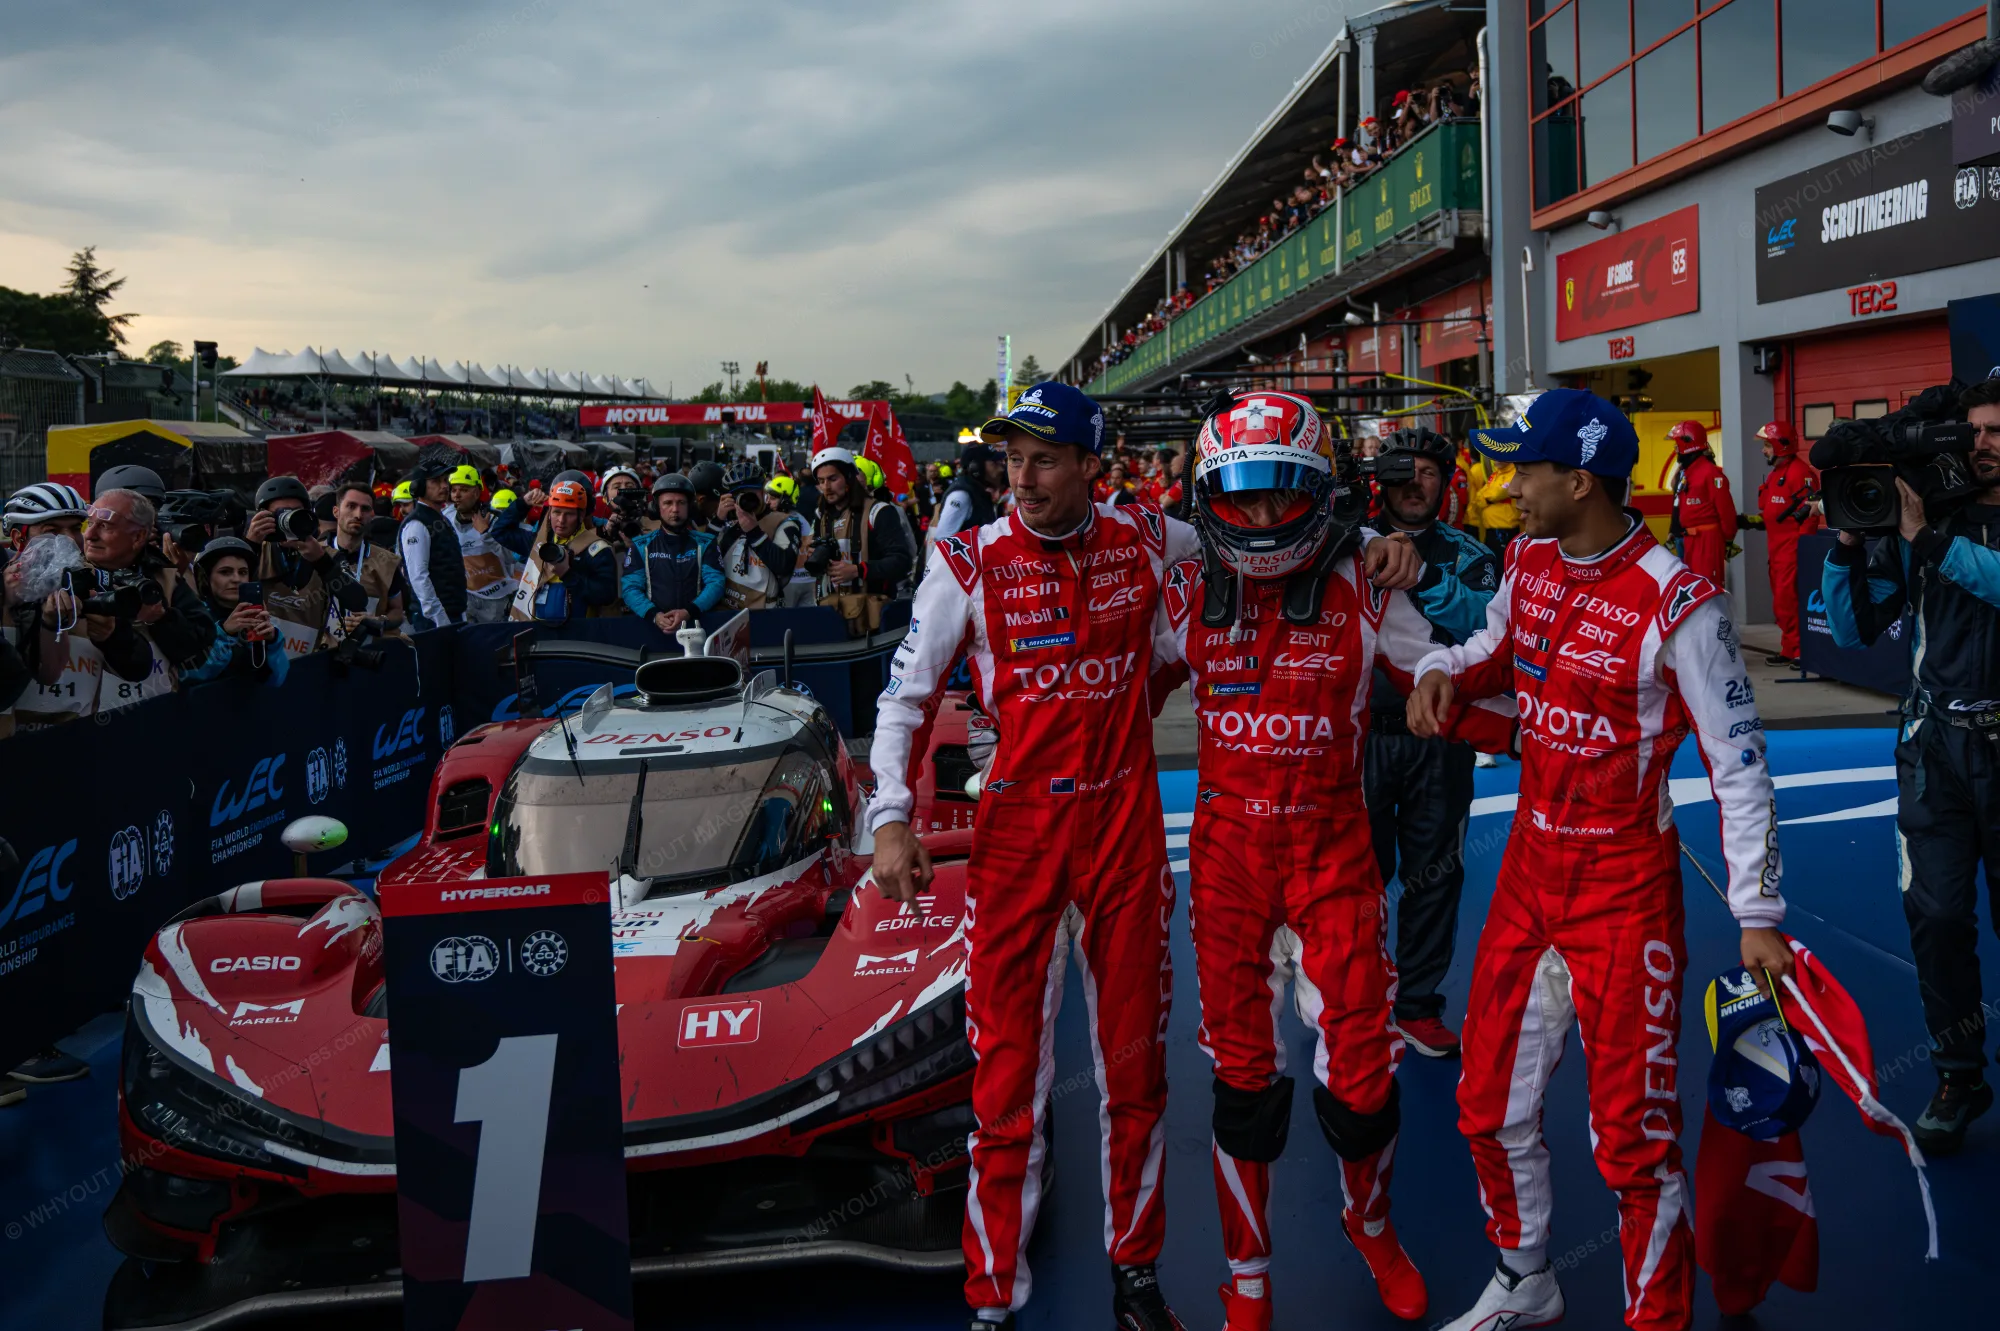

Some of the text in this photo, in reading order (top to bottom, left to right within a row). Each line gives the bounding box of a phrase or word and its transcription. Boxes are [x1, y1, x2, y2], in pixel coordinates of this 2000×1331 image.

[1821, 179, 1928, 244] SCRUTINEERING
[1672, 249, 1686, 276] 83
[1846, 281, 1898, 317] TEC2
[605, 407, 669, 423] MOTUL
[704, 406, 768, 422] MTUL
[1203, 450, 1249, 469] TOYOTA
[992, 555, 1056, 582] FUJITSU
[1082, 546, 1138, 568] DENSO
[1252, 564, 1280, 573] ZENT
[1003, 581, 1060, 600] AISIN
[1090, 569, 1128, 589] ZENT
[1519, 569, 1567, 601] FUJITSU
[1089, 585, 1143, 612] WEC
[1572, 593, 1641, 627] DENSO
[1005, 608, 1053, 627] Mobil
[1028, 635, 1070, 647] MICHELIN
[1289, 631, 1331, 648] ZENT
[1577, 620, 1619, 646] ZENT
[1013, 652, 1136, 689] TOYOTA
[1273, 652, 1344, 671] WEC
[1559, 641, 1626, 674] WEC
[118, 683, 143, 698] 81
[1202, 710, 1334, 741] TOYOTA
[1516, 691, 1618, 743] OYOTA
[373, 706, 425, 761] WEC
[584, 726, 731, 746] DENSO
[1210, 737, 1332, 756] RACING
[1519, 722, 1617, 757] ACING
[209, 753, 286, 827] WEC
[1284, 804, 1317, 814] BUEMI
[211, 839, 223, 851] FIA
[225, 825, 249, 847] WORLD
[1556, 825, 1614, 835] HIRAKAWA
[212, 834, 263, 865] CHAMPIONSHIP
[0, 837, 78, 930] EC
[440, 884, 551, 902] HYPERCAR
[18, 911, 76, 949] ENDURANCE
[875, 916, 955, 932] EDIFICE
[210, 956, 301, 973] CASIO
[854, 966, 915, 977] MARELLI
[1720, 992, 1767, 1018] MICHEL
[229, 1015, 298, 1027] MARELLI
[684, 1007, 755, 1040] HY
[1640, 939, 1678, 1142] DENSO
[453, 1033, 558, 1283] 1
